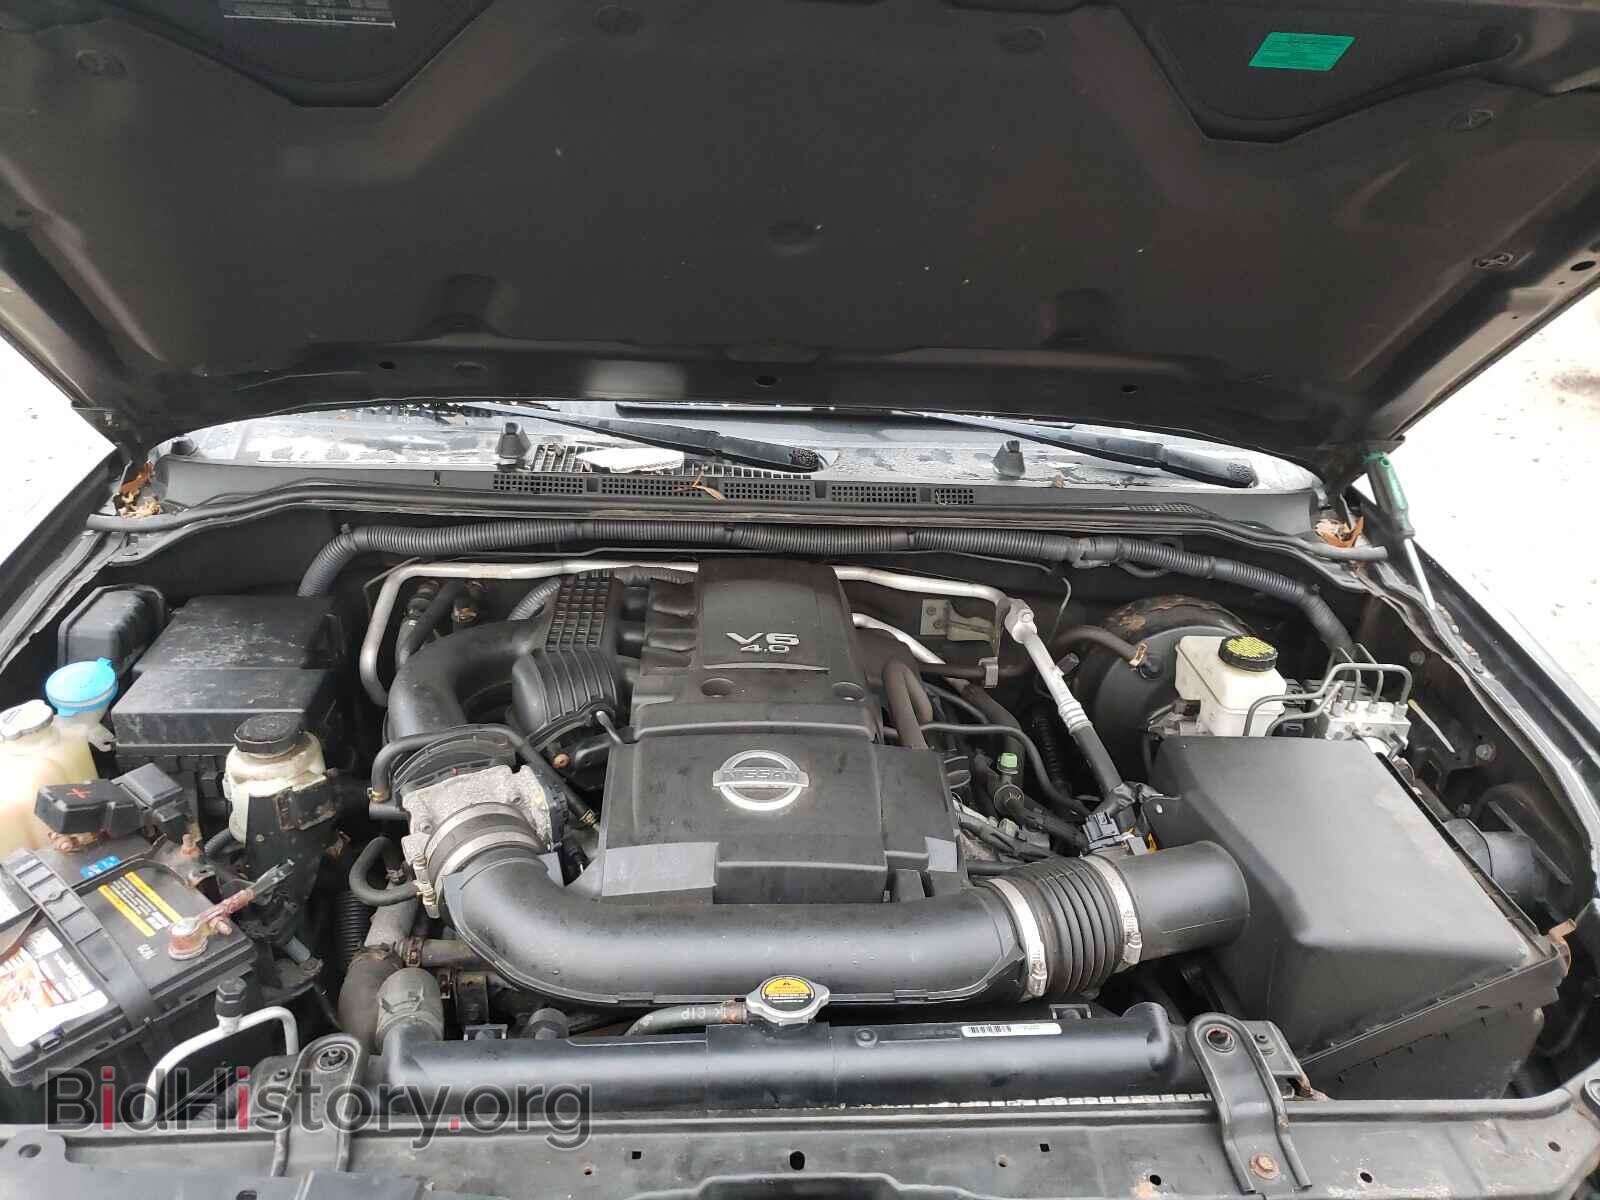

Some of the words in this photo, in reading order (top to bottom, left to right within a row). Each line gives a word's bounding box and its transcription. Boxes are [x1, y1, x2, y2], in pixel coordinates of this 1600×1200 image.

[725, 632, 800, 646] V6
[740, 644, 790, 653] 4.0
[722, 768, 799, 780] NISSAN
